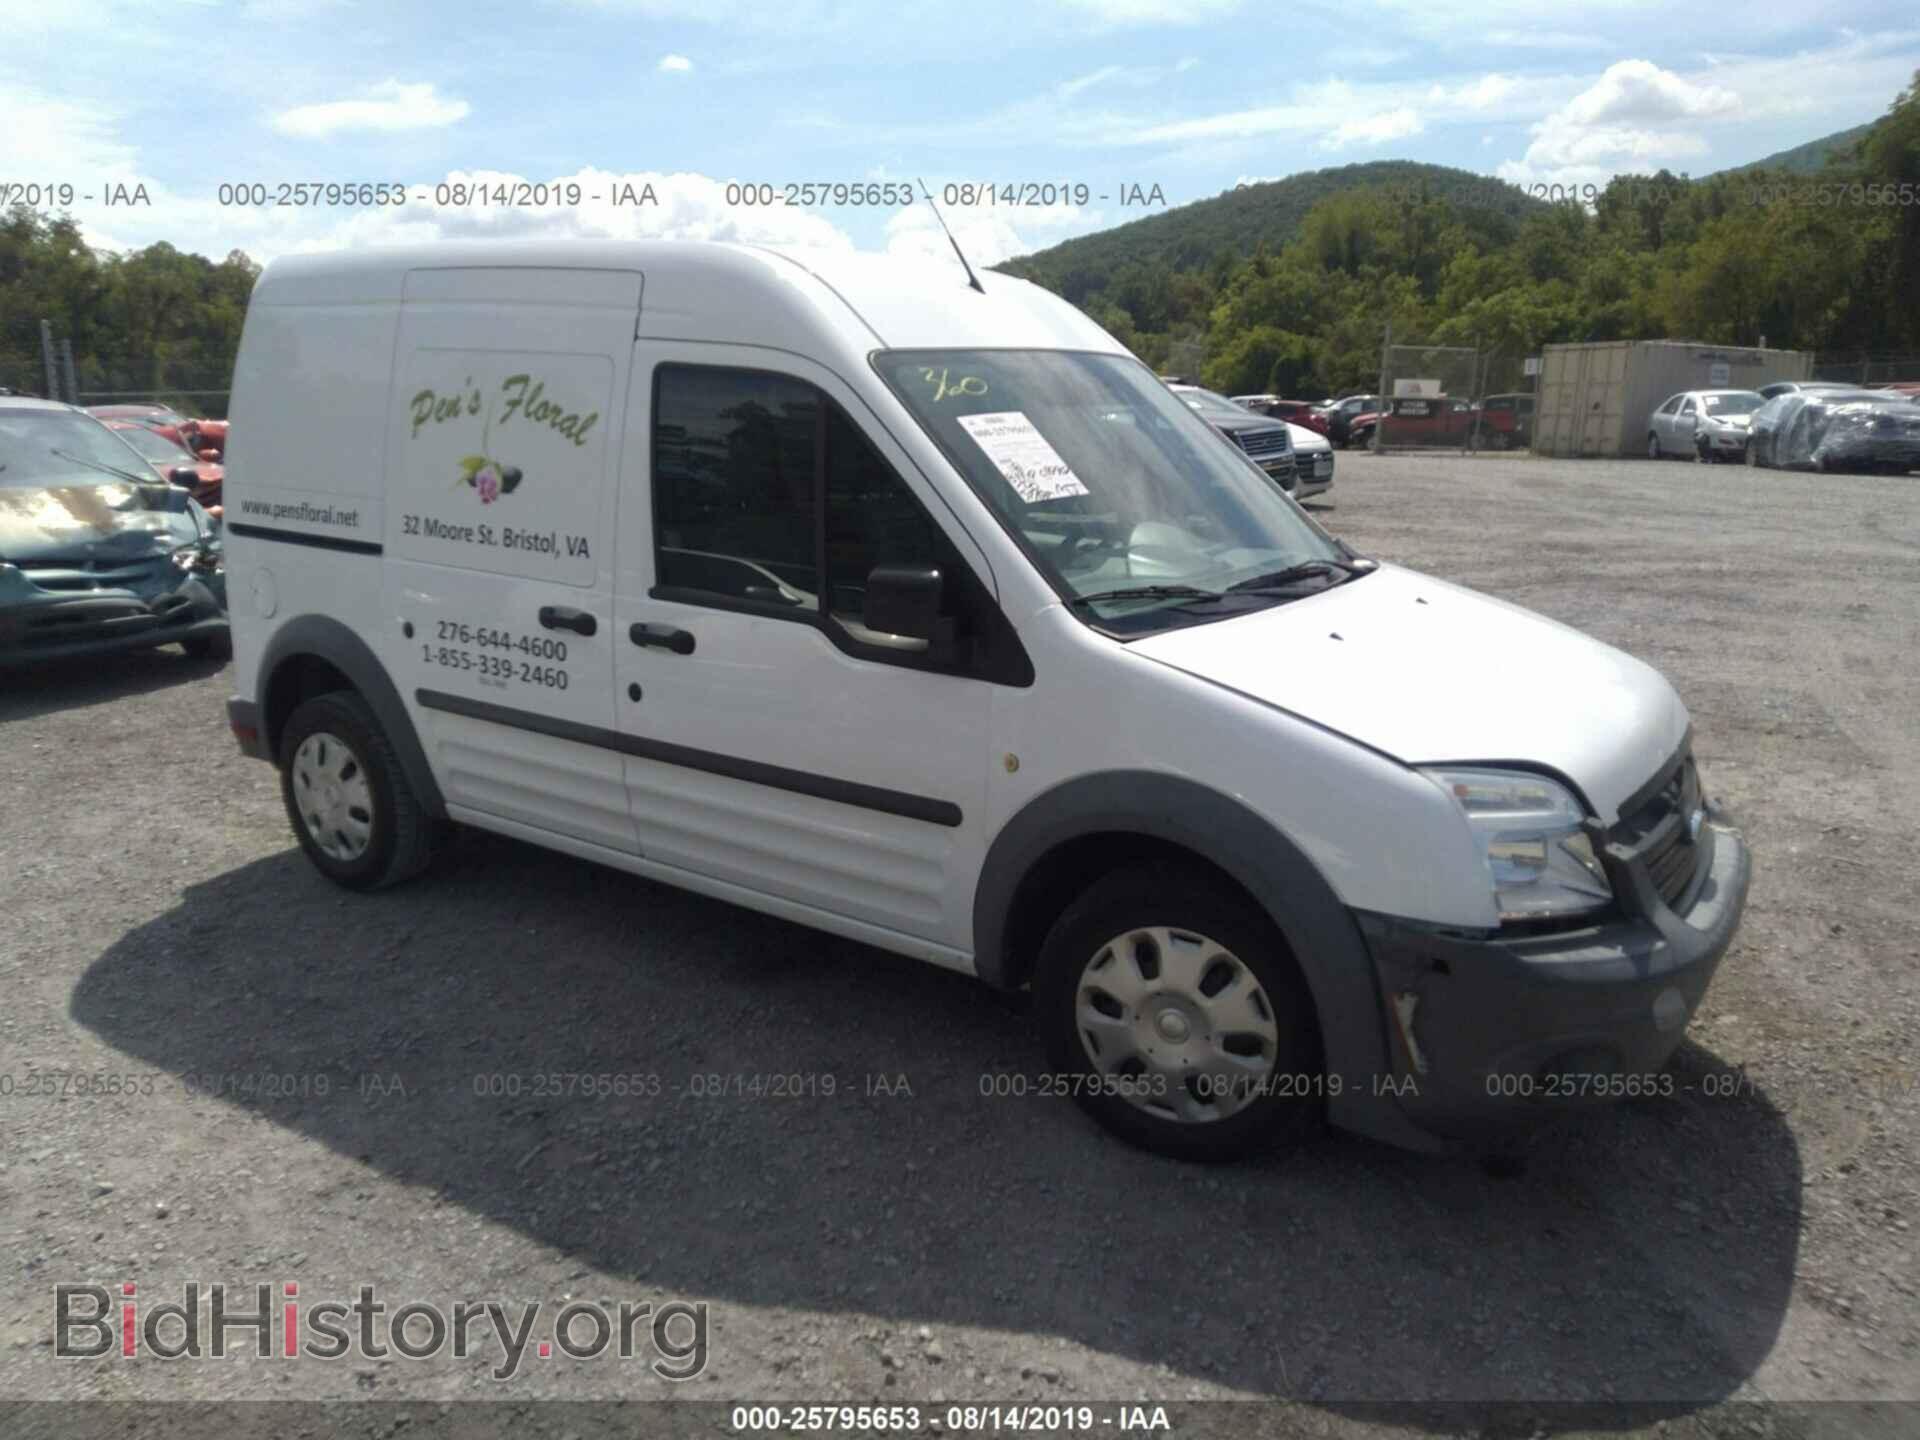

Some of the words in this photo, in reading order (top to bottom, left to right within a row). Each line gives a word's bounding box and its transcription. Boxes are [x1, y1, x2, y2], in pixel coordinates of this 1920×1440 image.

[411, 376, 481, 440] Pen's
[499, 374, 598, 447] Floral
[240, 499, 359, 528] www.pensfloral.net
[402, 514, 420, 535] 32
[423, 516, 474, 543] Moore
[477, 523, 498, 546] St.
[502, 527, 561, 559] Bristol,
[566, 535, 590, 559] VA
[437, 620, 568, 662] 276-644-4600
[421, 644, 569, 690] 1-855-339-2460
